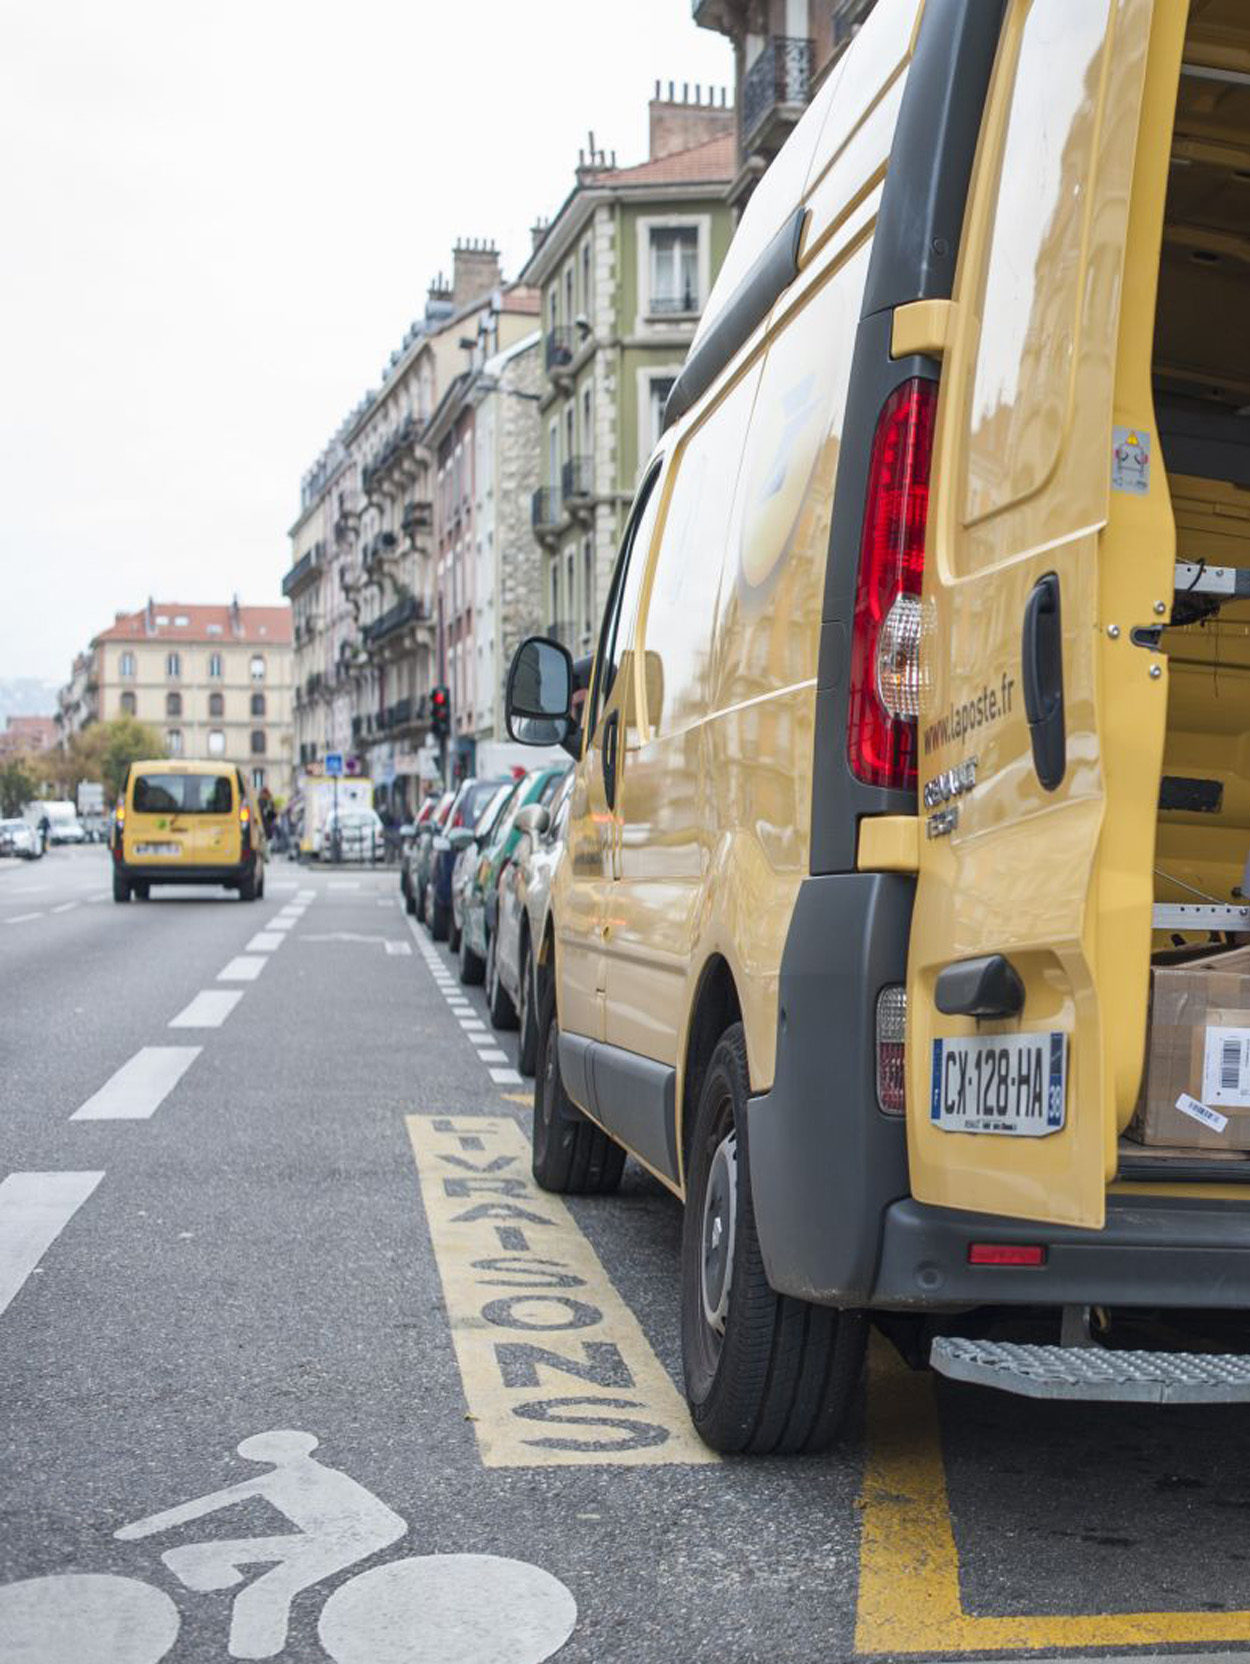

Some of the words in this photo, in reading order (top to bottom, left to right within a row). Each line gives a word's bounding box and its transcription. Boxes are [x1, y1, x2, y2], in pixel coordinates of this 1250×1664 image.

[924, 672, 1014, 756] www.laposte.fr
[944, 1047, 1043, 1118] CX-128-HA
[431, 1118, 671, 1453] LIVRAISONS
